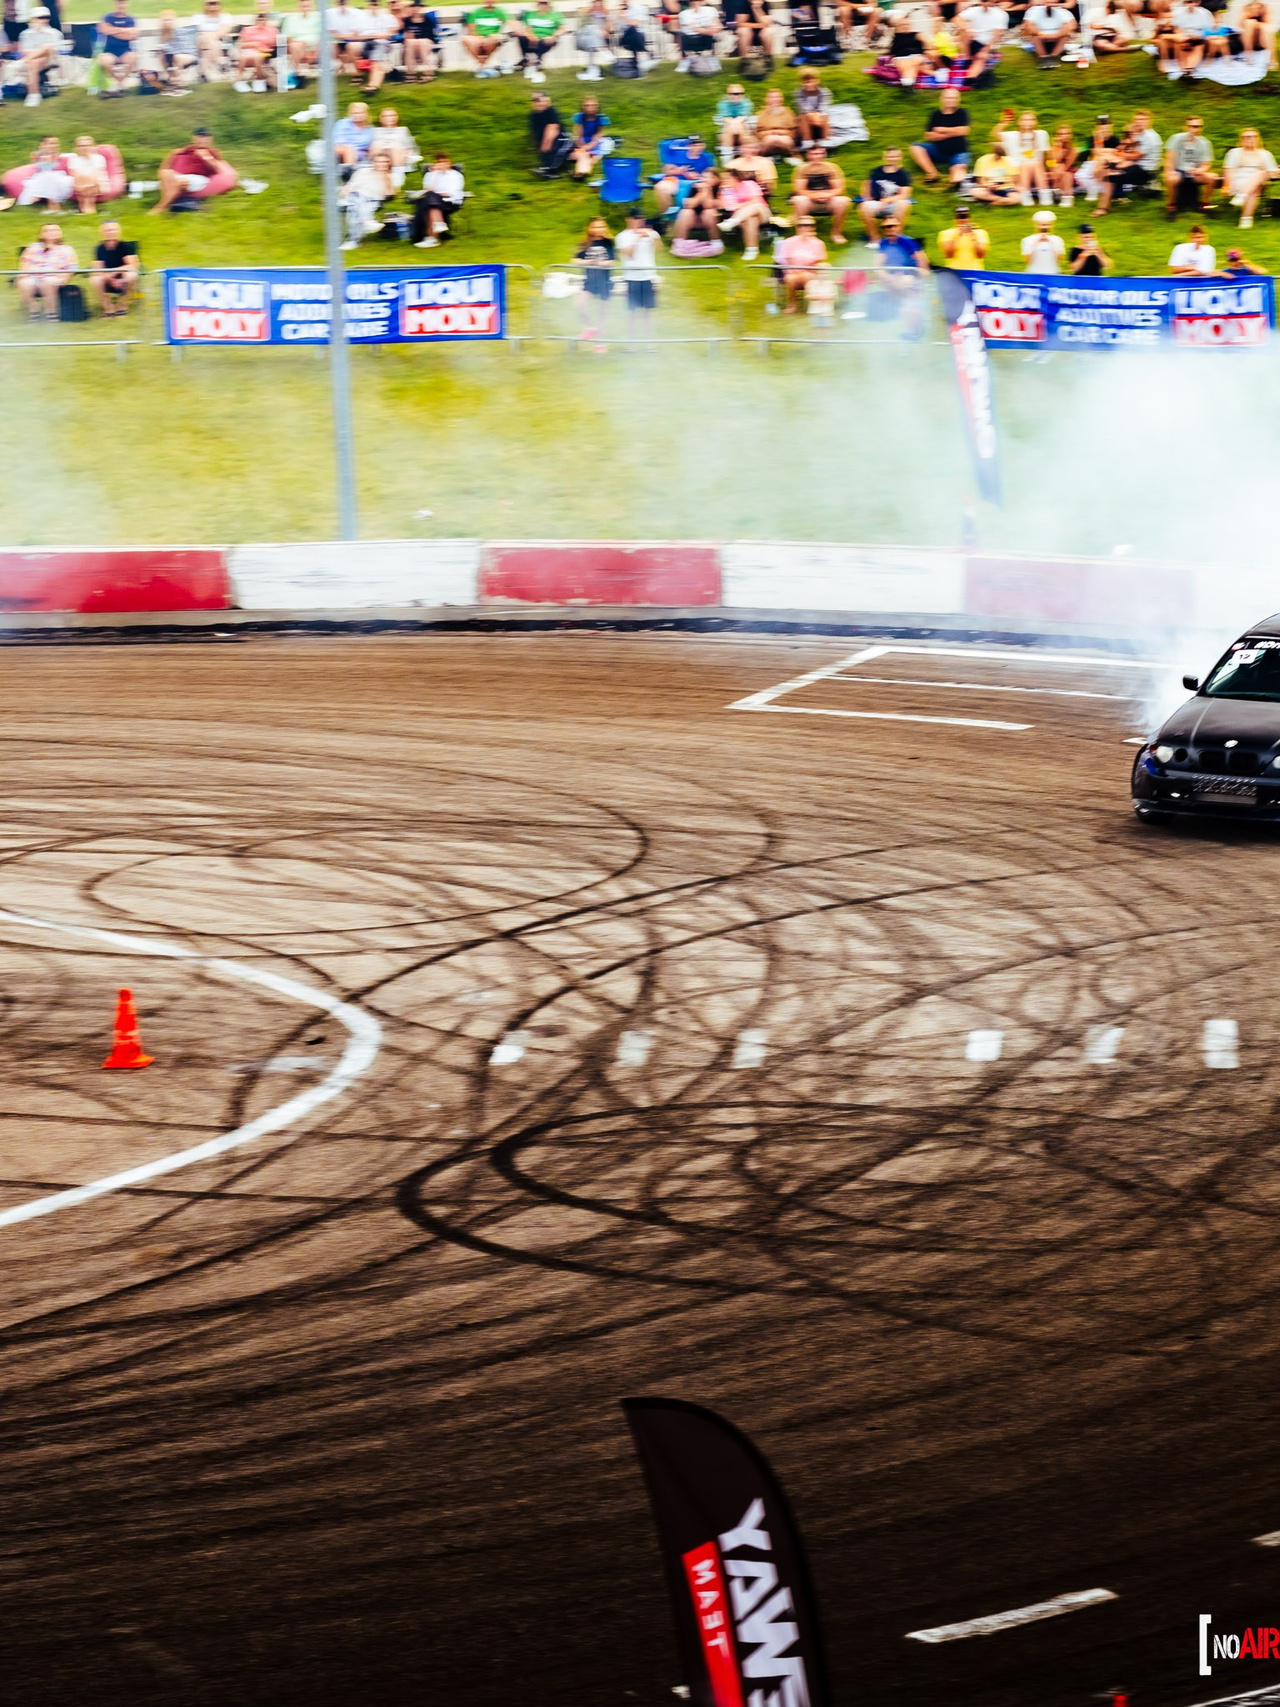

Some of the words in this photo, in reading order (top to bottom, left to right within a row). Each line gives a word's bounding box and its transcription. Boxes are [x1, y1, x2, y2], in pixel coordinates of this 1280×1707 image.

[175, 281, 264, 309] LIQUI
[270, 284, 333, 300] MOTO
[346, 282, 399, 300] OILS
[404, 276, 495, 306] LIQUI
[972, 282, 1041, 309] IQUI
[1047, 287, 1119, 305] MOTOR
[1120, 290, 1170, 306] OILS
[1174, 287, 1263, 315] LIQUI
[176, 310, 267, 337] MOLY
[342, 320, 389, 338] ARE
[404, 305, 497, 334] MOLY
[977, 311, 1044, 338] OLY
[1175, 317, 1267, 343] MOLY
